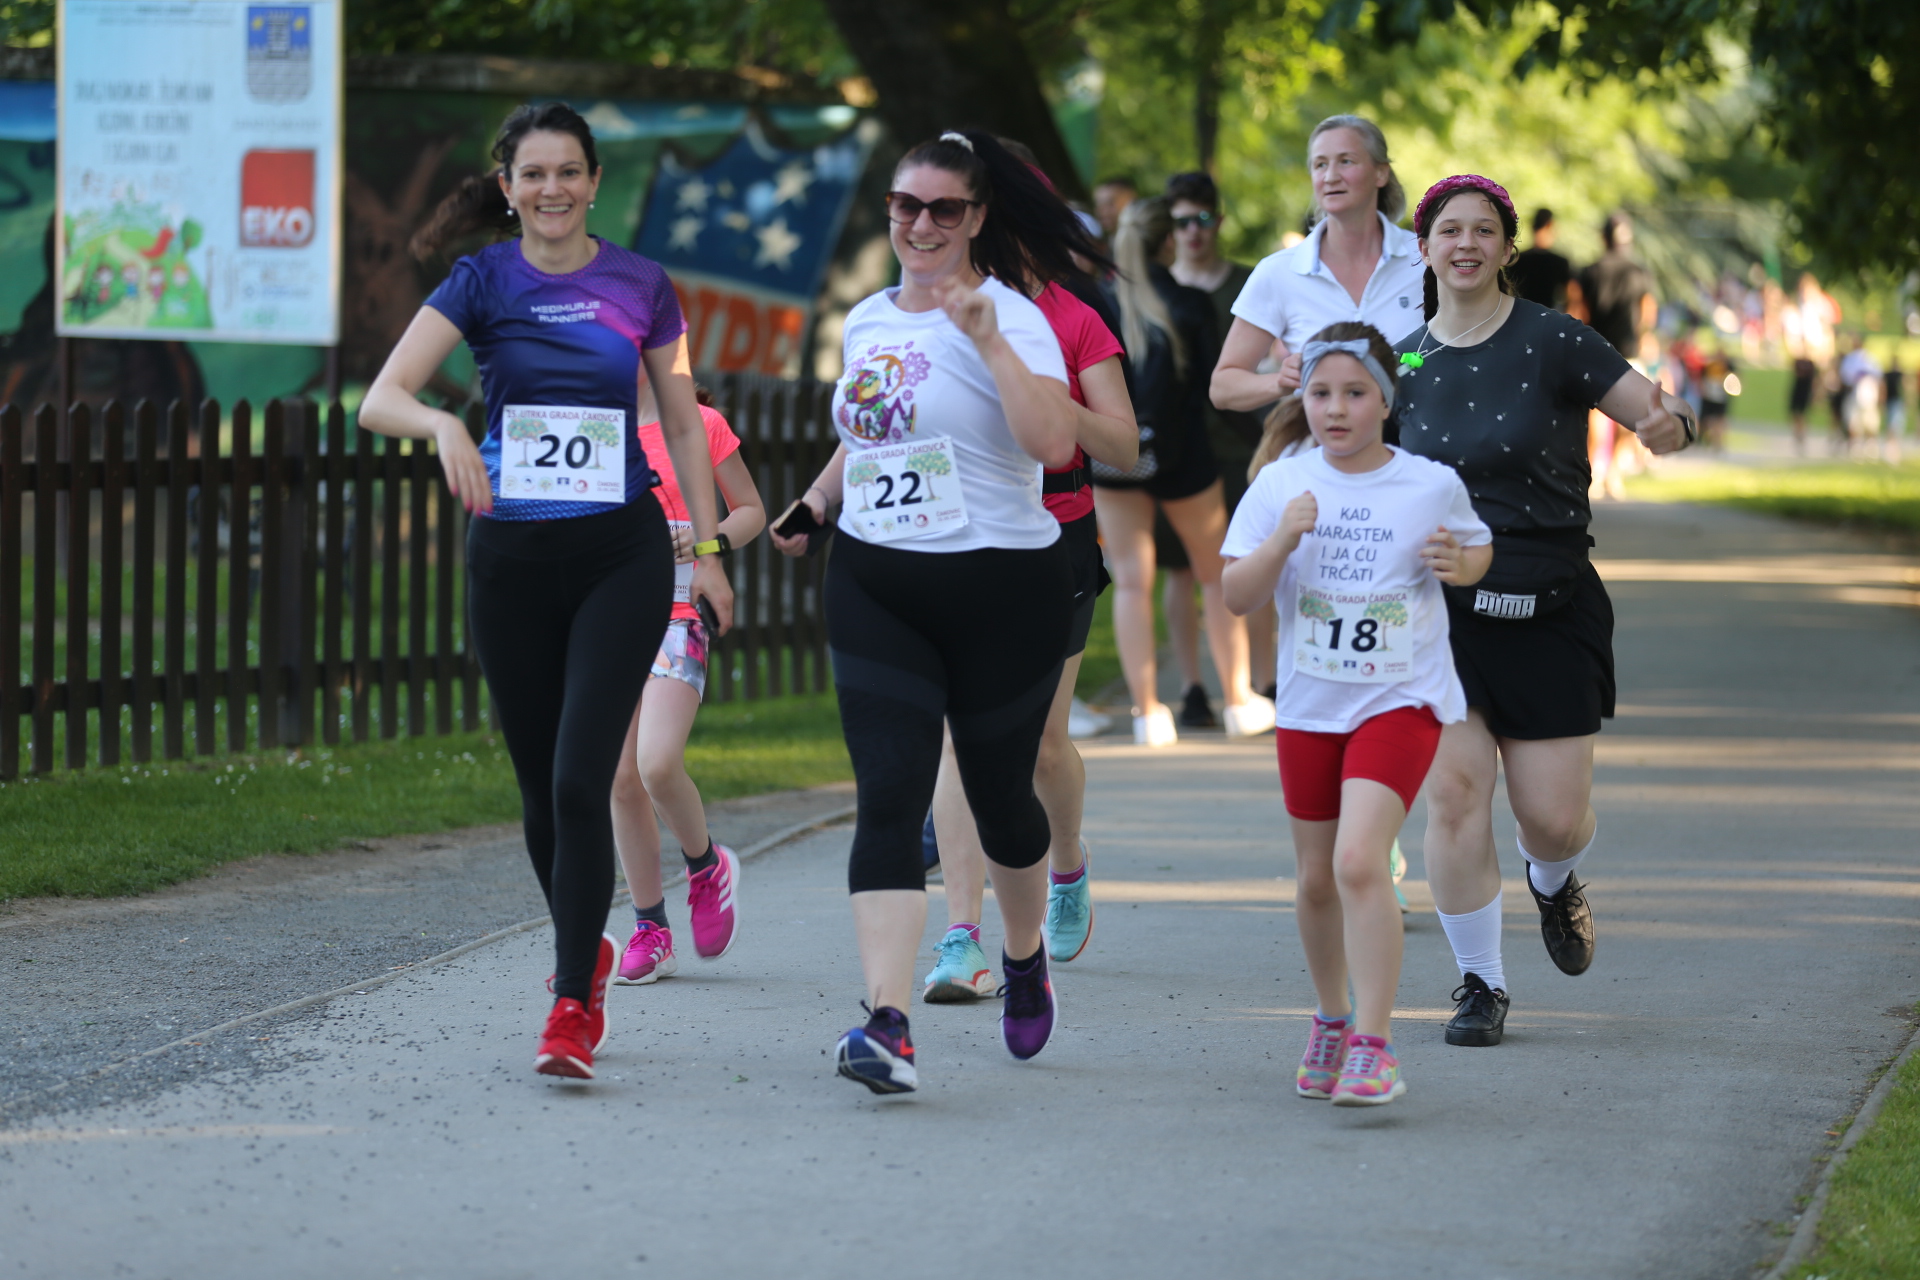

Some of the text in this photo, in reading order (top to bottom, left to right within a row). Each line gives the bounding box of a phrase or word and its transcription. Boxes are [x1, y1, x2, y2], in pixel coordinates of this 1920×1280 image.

[243, 207, 314, 246] EKO
[538, 311, 596, 324] RUNNERS
[520, 410, 547, 419] UTRKA
[549, 411, 580, 420] GRADA
[582, 410, 619, 423] ČAKOVCA
[535, 434, 592, 469] 20
[859, 451, 880, 463] UTRKA
[880, 448, 906, 459] GRADA
[907, 442, 947, 455] ČAKOVCA
[874, 471, 923, 509] 22
[1340, 507, 1371, 521] KAD
[1311, 525, 1394, 542] NARASTEM
[1321, 545, 1377, 562] I JA ĆU
[1319, 564, 1373, 581] TRČATI
[1309, 588, 1334, 601] UTRKA
[1335, 594, 1367, 604] GRADA
[1368, 593, 1408, 604] ČAKOVCA
[1473, 593, 1536, 618] PUMA
[1328, 618, 1378, 653] 18
